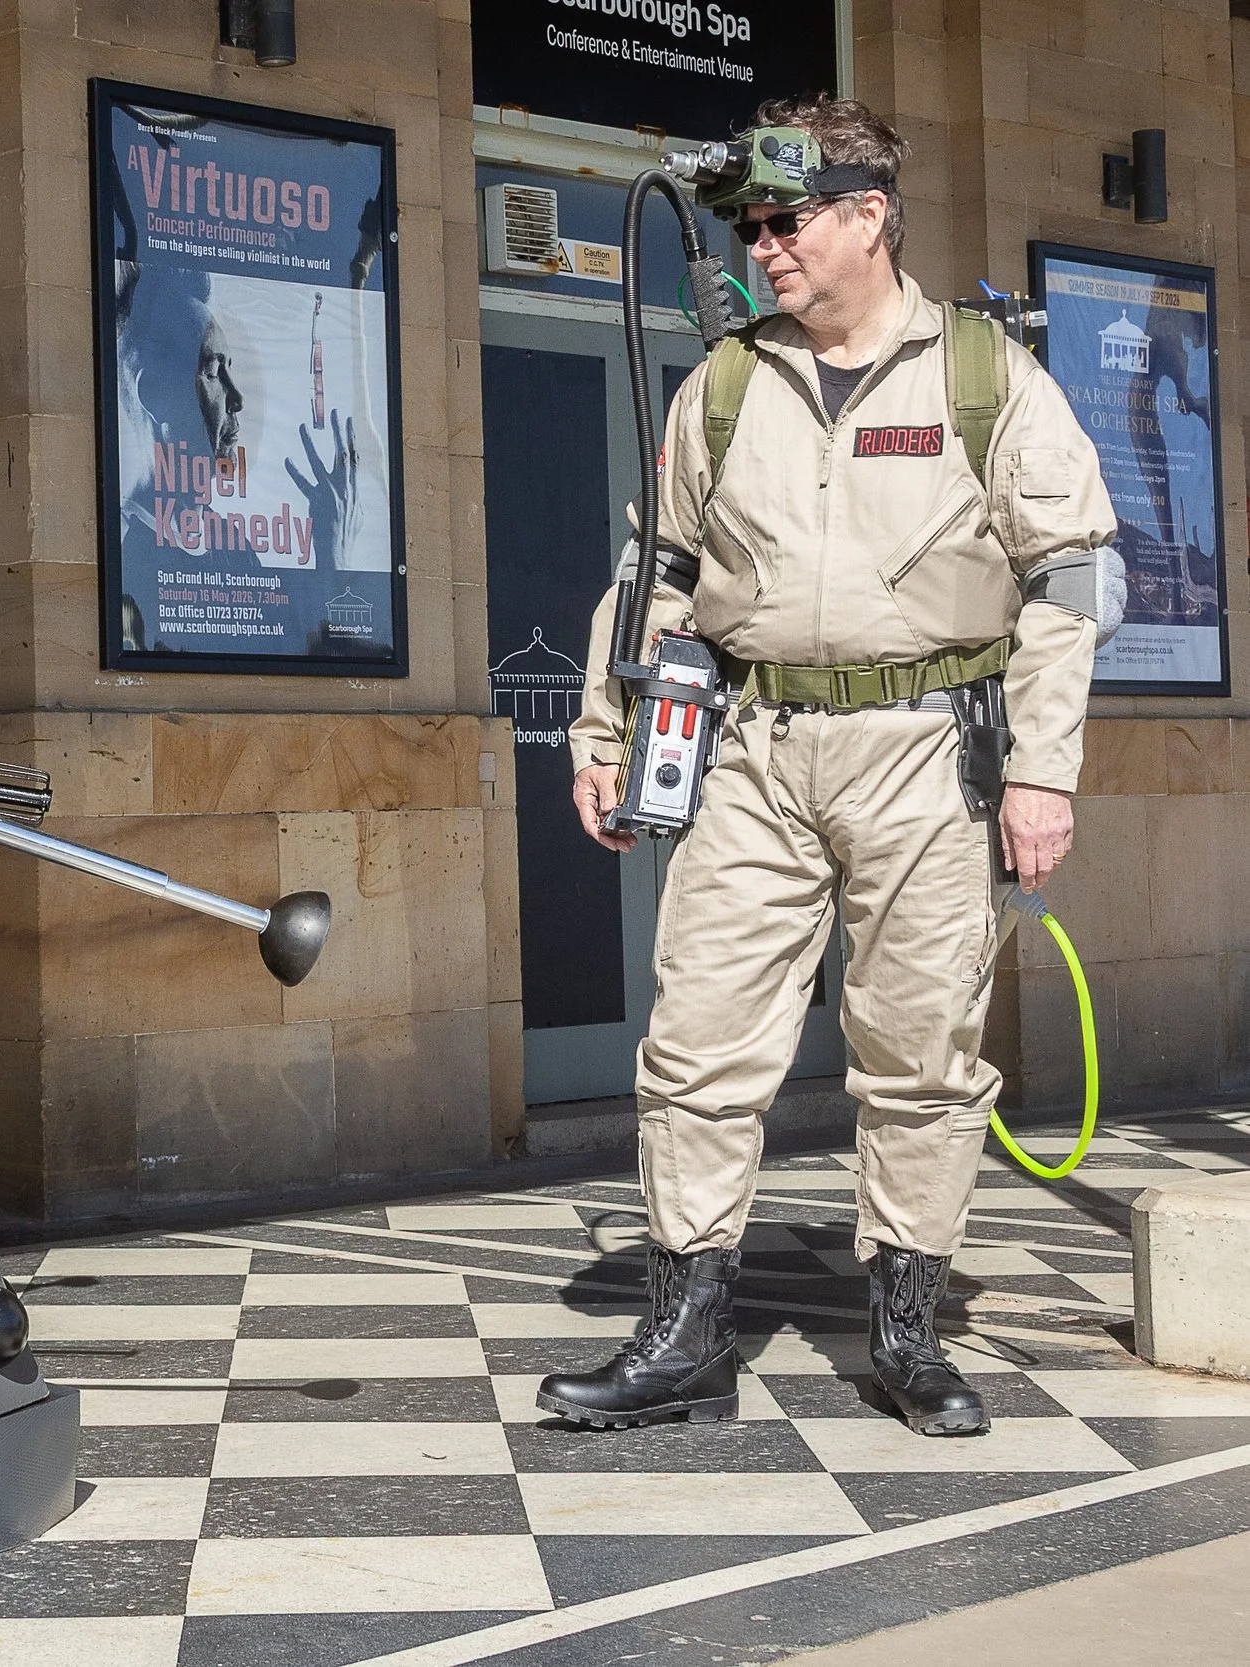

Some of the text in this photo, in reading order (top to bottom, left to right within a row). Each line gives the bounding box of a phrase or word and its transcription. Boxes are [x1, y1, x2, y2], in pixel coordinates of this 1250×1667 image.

[547, 0, 751, 47] orough Spa
[547, 24, 753, 82] Conference & Entertainment Venue
[137, 123, 217, 143] Derek Block Proudly Presents
[127, 144, 330, 231] A Virtuoso
[146, 212, 276, 248] Concert Performance
[148, 236, 330, 271] from the biggest selling violinist in the world
[583, 247, 610, 259] Caution
[1068, 279, 1094, 294] SUMMER
[1095, 283, 1119, 298] SEASON
[1150, 290, 1164, 305] SEPT
[1099, 375, 1154, 390] THE LEGENDARY
[1067, 385, 1187, 414] SCARBOROUGH SPA
[1090, 410, 1164, 435] ORCHESTRA
[859, 427, 941, 455] RUDDERS
[153, 440, 247, 505] Nigel
[1135, 473, 1154, 484] Sundays
[1154, 475, 1166, 484] 2pm
[1121, 492, 1136, 503] from
[1136, 494, 1150, 507] only
[155, 497, 313, 565] Kennedy
[157, 570, 281, 590] Spa Grand Hall, Scarborough
[158, 587, 289, 607] Saturday 16 May 2026, 7.30pm
[159, 604, 264, 620] Box Office 01723 376774
[159, 620, 285, 637] www.scarboroughspa.co.uk
[328, 624, 373, 634] Scarborough Spa
[1115, 645, 1174, 656] scarboroughspa.co.uk
